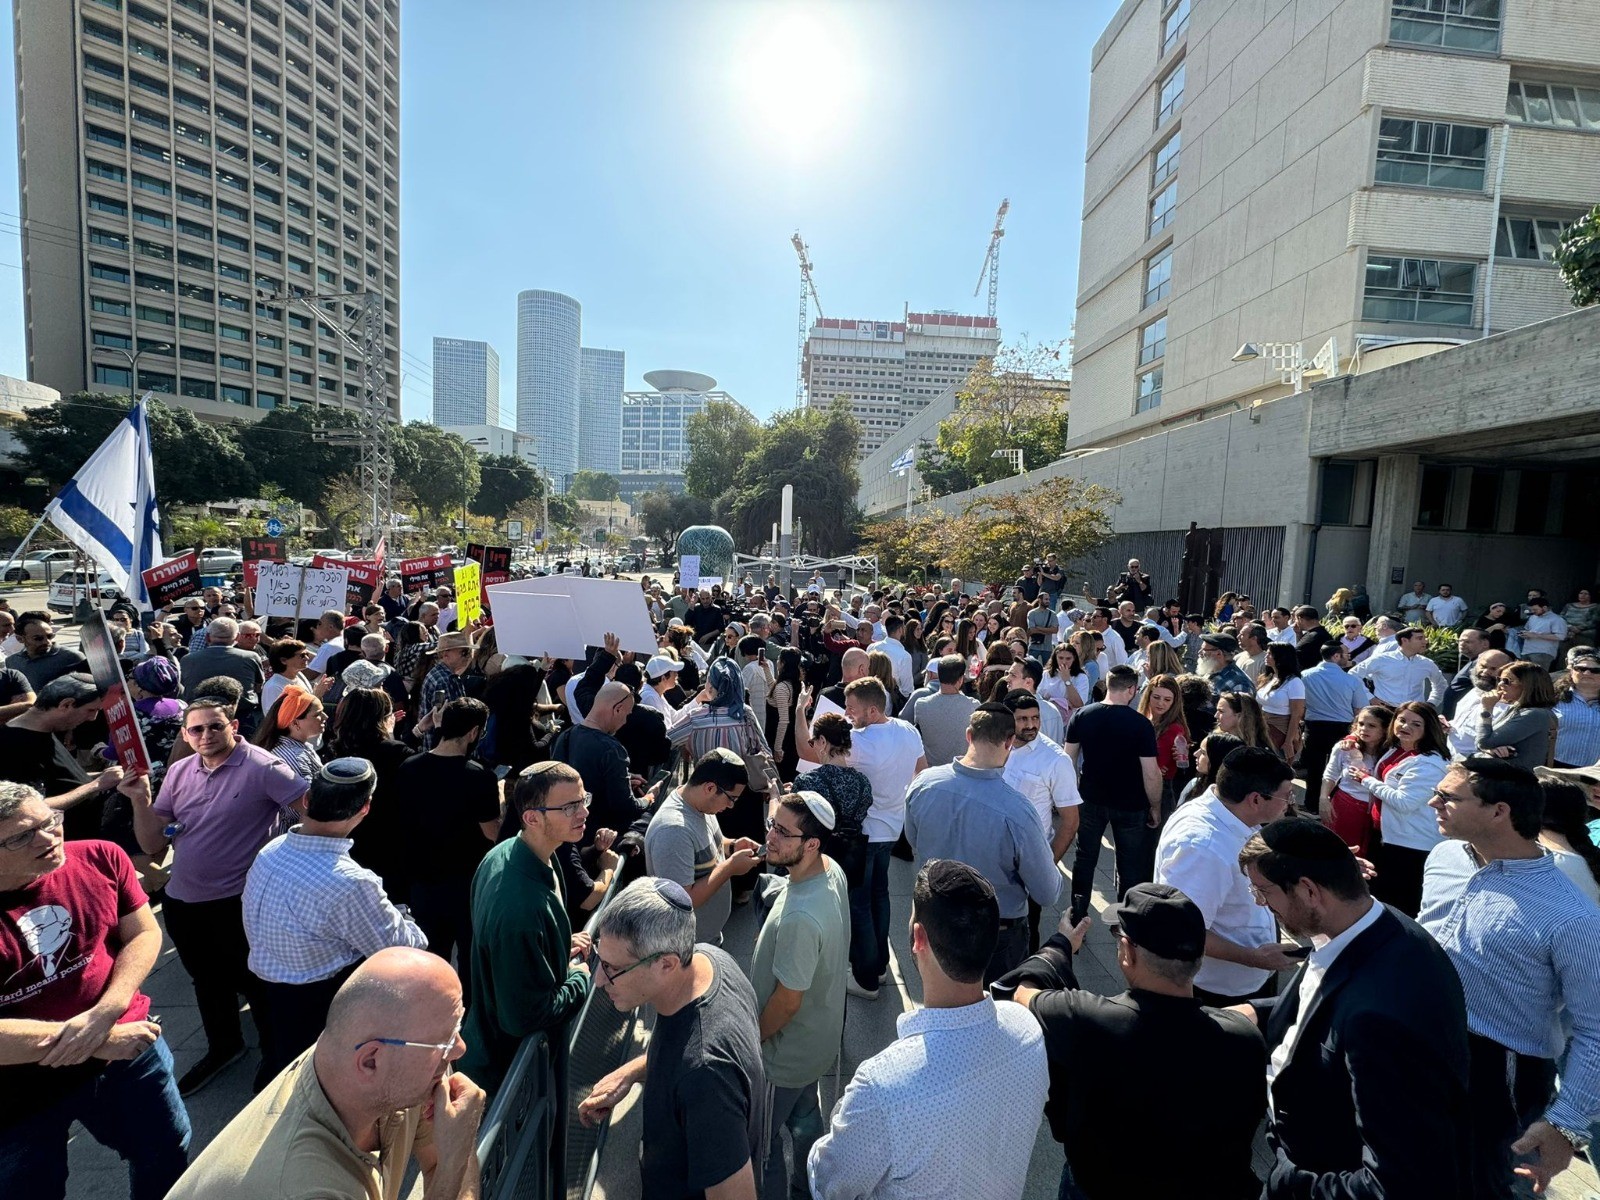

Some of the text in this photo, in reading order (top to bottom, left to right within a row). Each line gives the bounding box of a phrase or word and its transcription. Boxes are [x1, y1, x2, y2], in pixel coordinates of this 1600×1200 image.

[249, 540, 277, 556] די!
[405, 560, 429, 571] שחררו
[489, 550, 507, 568] די!
[152, 559, 189, 582] שחררו
[179, 576, 190, 586] את
[26, 973, 58, 994] means
